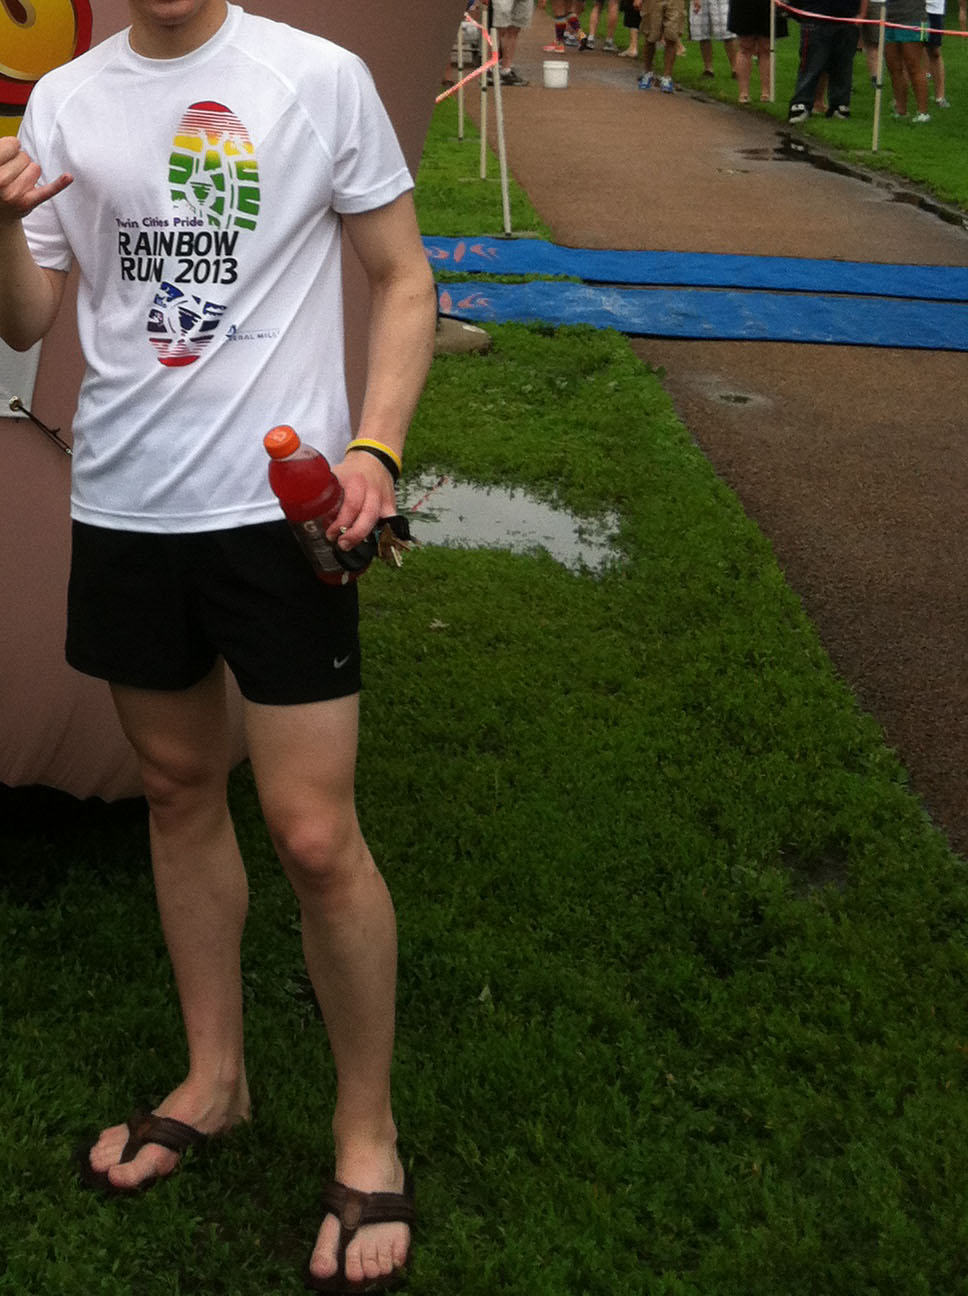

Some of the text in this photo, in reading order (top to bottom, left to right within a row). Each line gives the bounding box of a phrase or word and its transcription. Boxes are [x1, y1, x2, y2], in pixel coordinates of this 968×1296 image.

[115, 217, 204, 228] Twin Cities Pride
[118, 230, 239, 257] RAINBOW
[120, 256, 238, 285] RUN 2013
